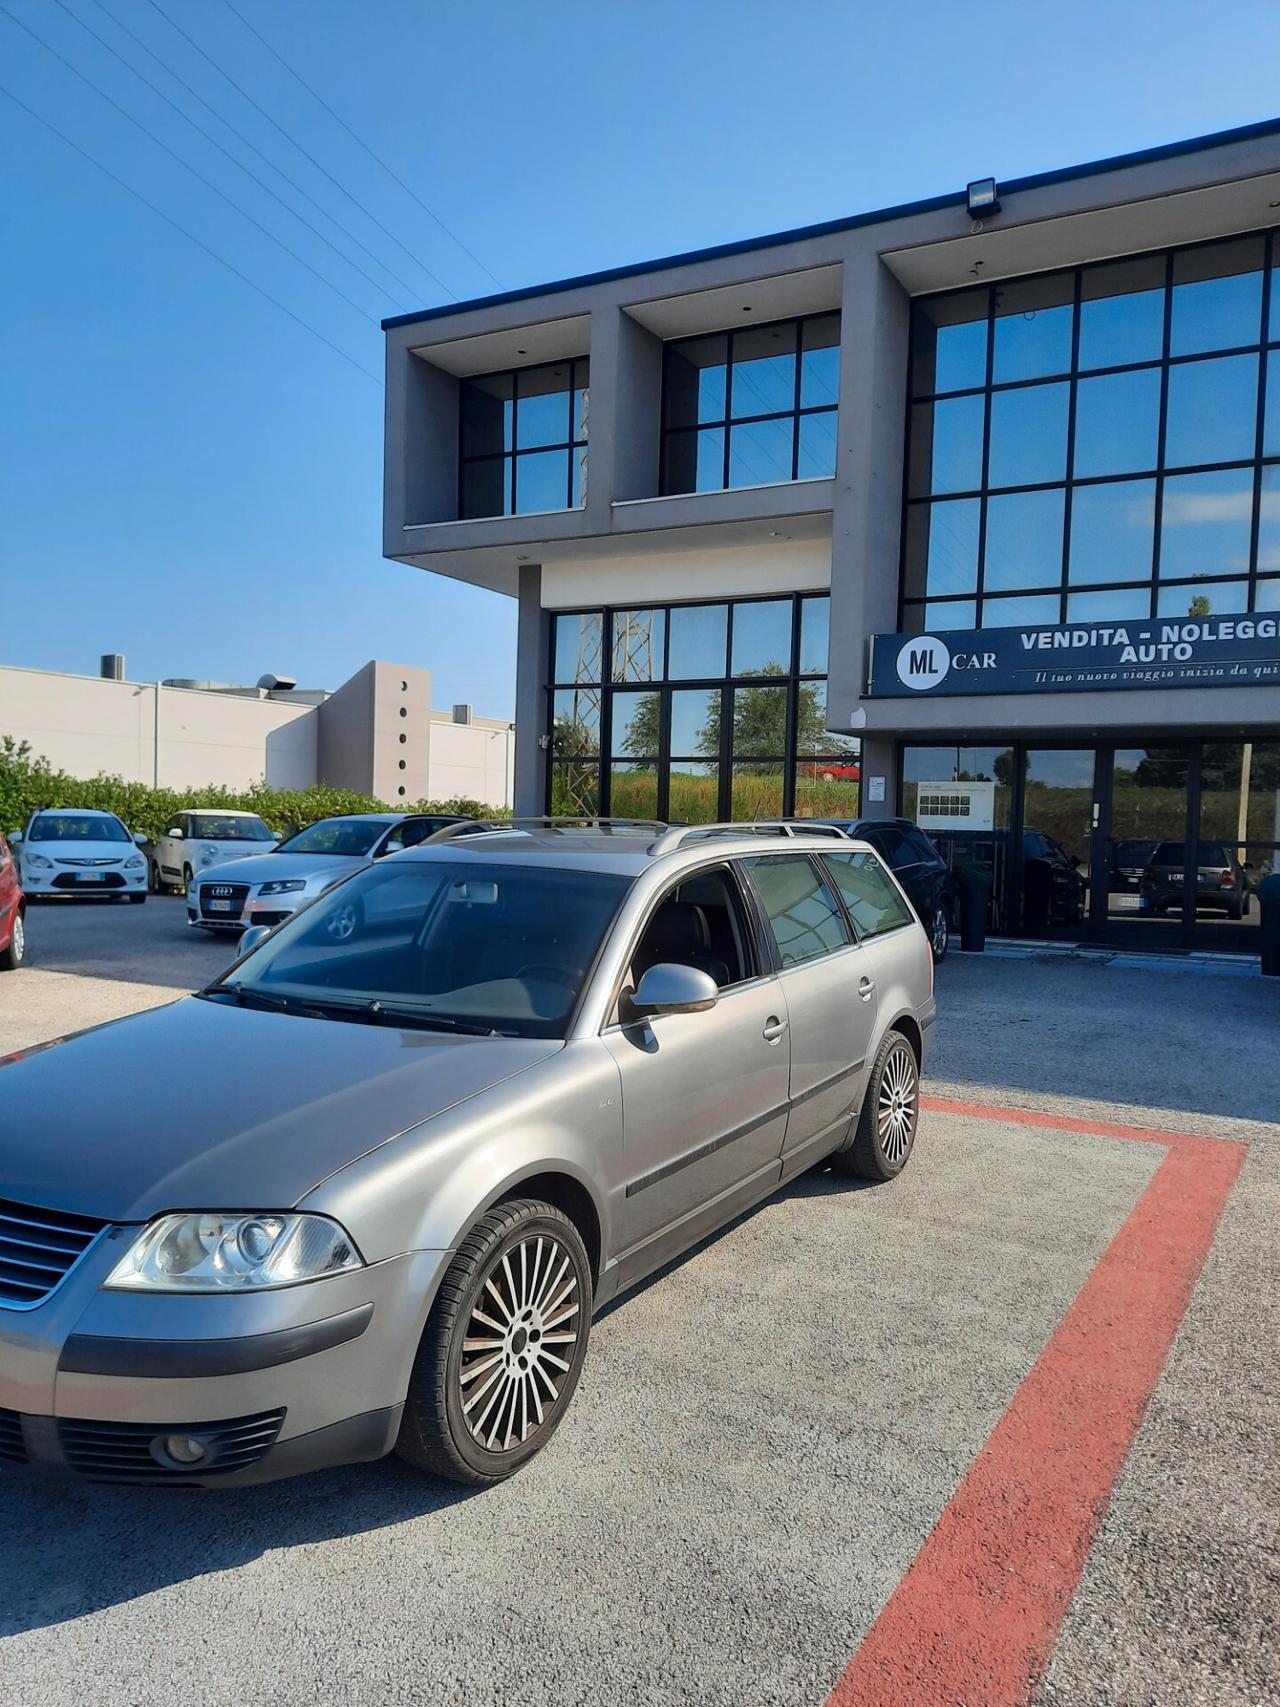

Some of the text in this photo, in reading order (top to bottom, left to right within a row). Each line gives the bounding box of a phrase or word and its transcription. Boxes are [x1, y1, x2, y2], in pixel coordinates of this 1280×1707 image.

[1020, 628, 1131, 650] VENDITA
[1161, 619, 1280, 643] NOLEGG
[909, 649, 998, 675] ML CAR
[1119, 643, 1193, 663] AUTO
[1034, 662, 1280, 683] Il tuo nuovo viaggio inizia da qui
